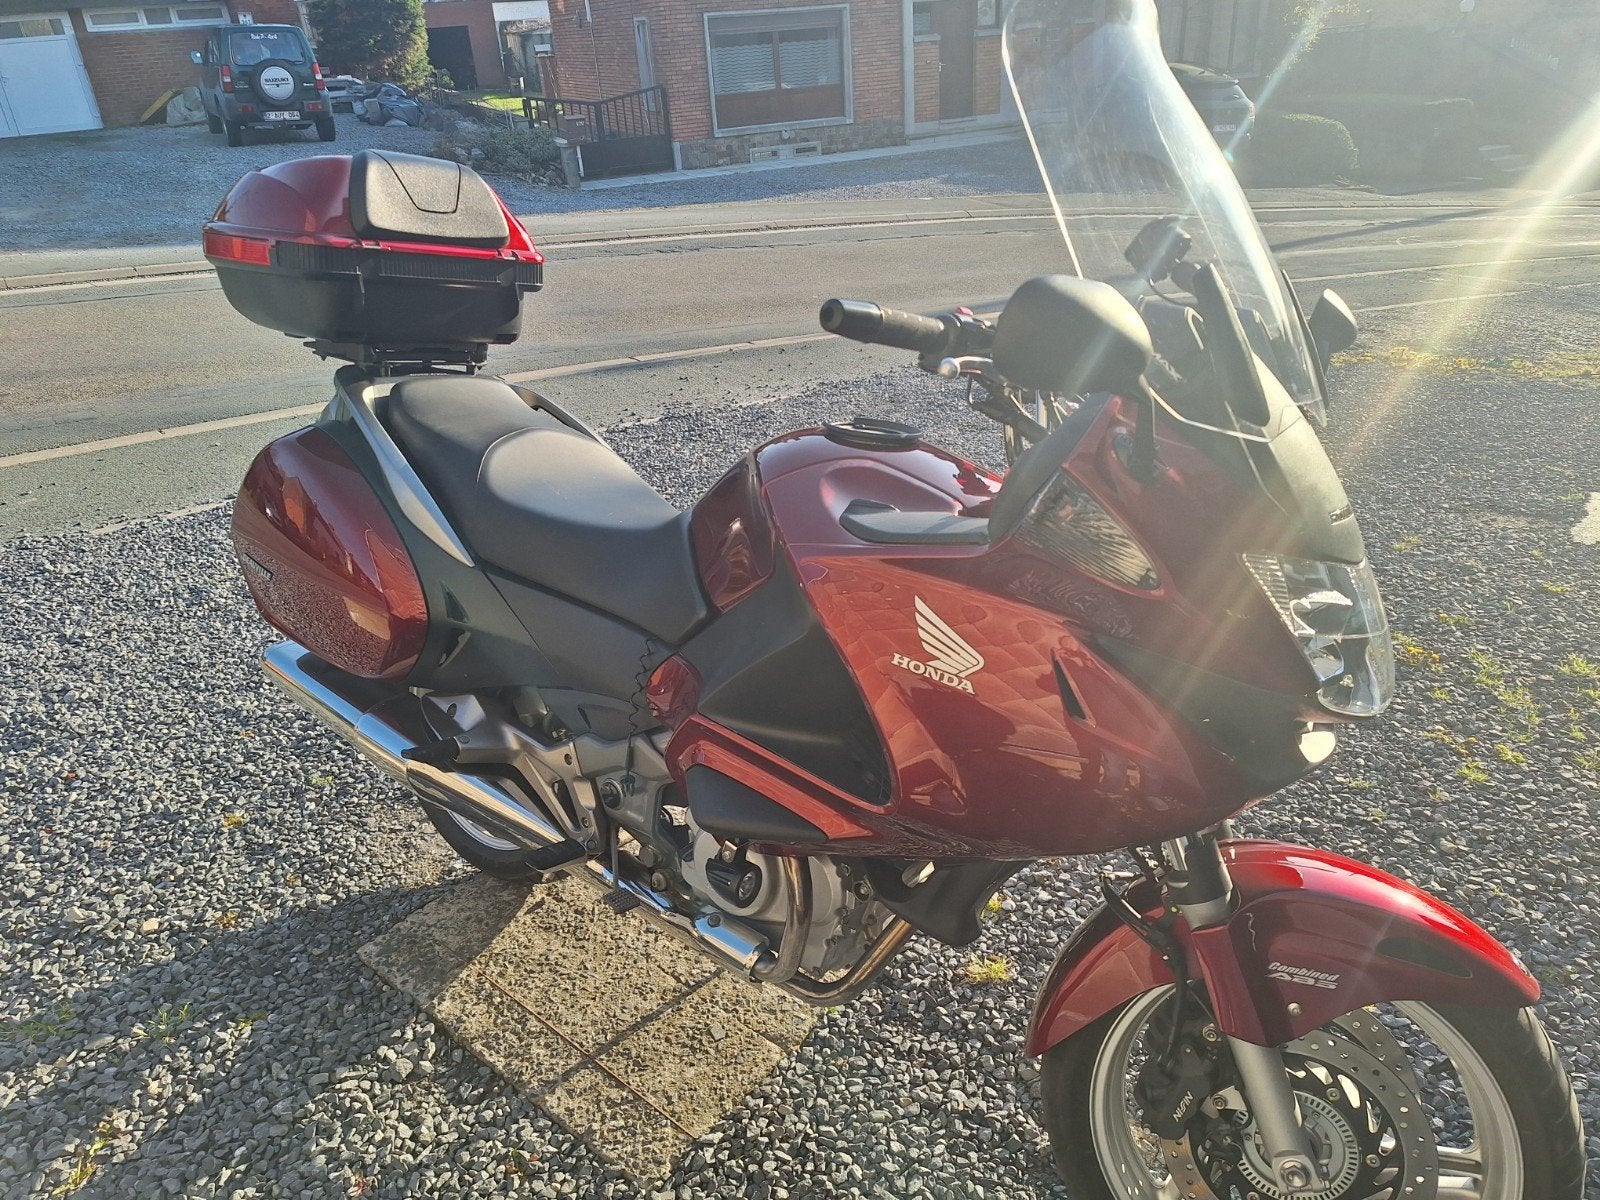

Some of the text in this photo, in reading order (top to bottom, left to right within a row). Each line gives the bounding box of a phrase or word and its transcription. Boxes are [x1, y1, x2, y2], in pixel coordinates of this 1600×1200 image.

[890, 652, 976, 695] HONDA
[1264, 971, 1339, 990] ABS
[1268, 961, 1340, 982] Combined
